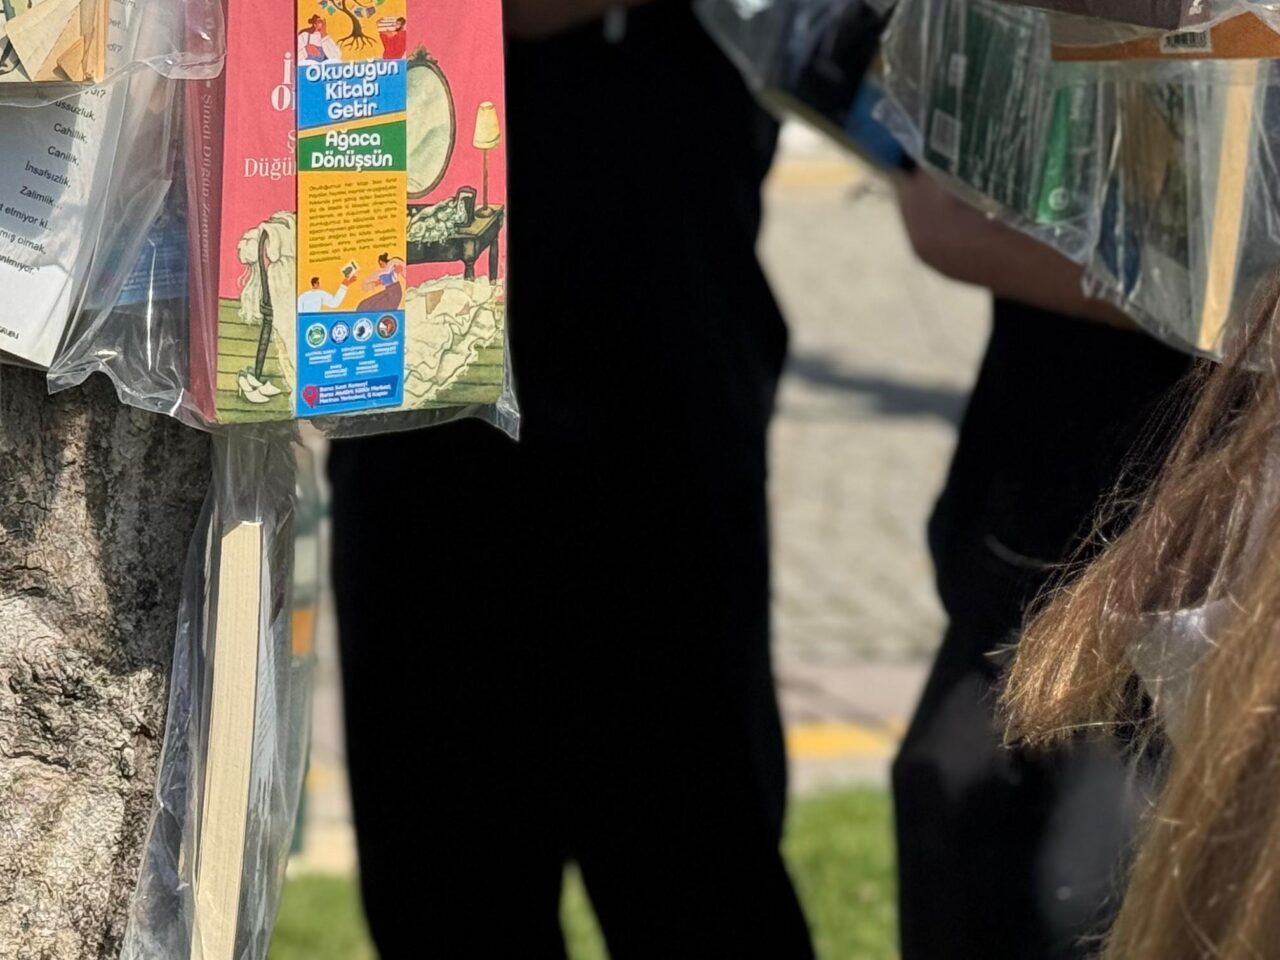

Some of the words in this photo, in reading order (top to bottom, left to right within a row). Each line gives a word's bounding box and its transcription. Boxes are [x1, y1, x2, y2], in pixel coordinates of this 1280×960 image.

[305, 58, 399, 82] Okuduğun
[325, 78, 379, 100] Kitabı
[327, 99, 378, 119] Getir
[325, 129, 381, 151] Ağaca
[244, 156, 296, 181] Düğü
[311, 149, 393, 172] Dönüşsün
[4, 206, 39, 225] etmiyor
[17, 236, 47, 255] olmak,
